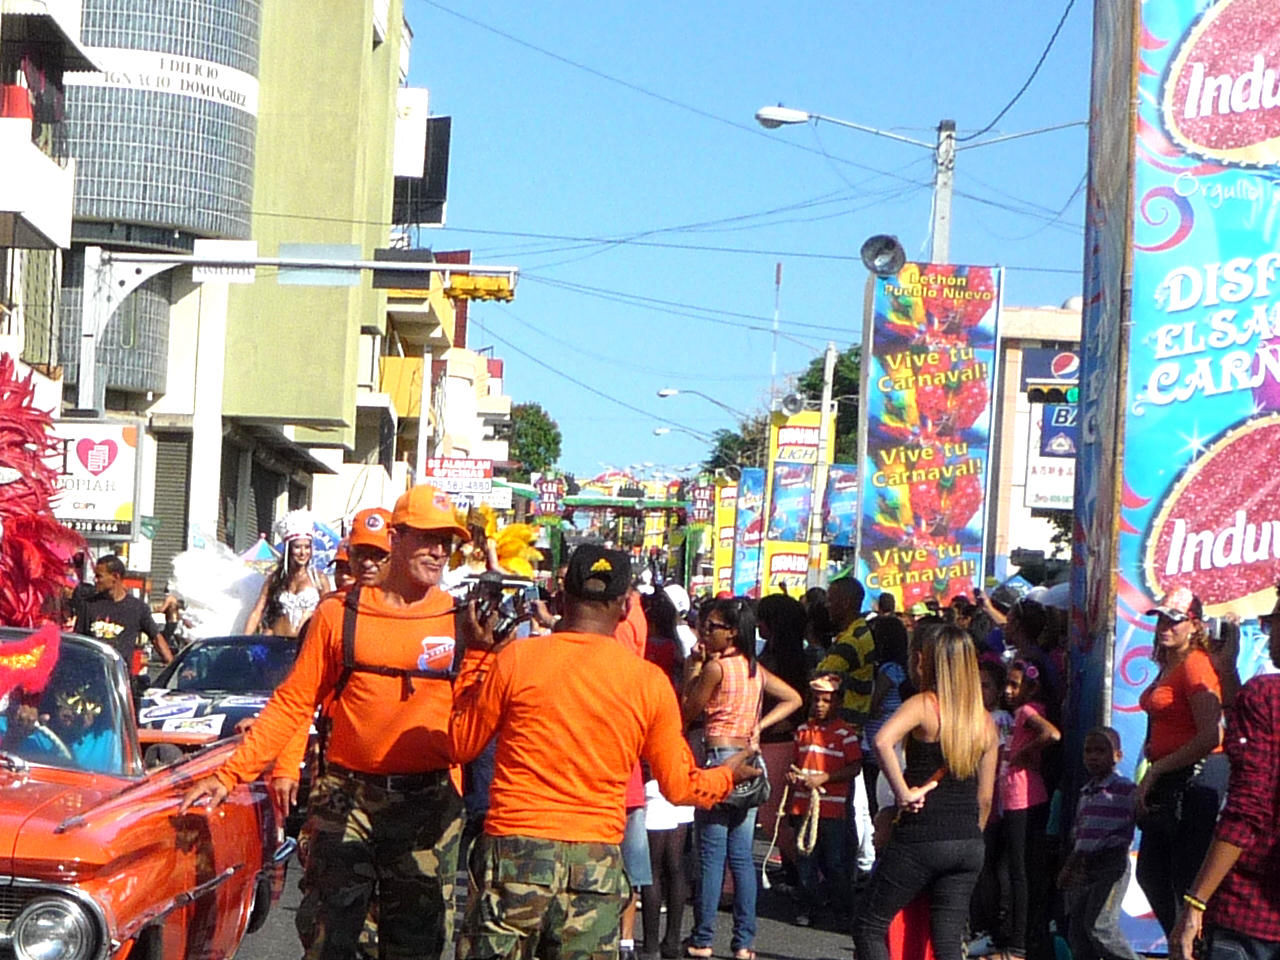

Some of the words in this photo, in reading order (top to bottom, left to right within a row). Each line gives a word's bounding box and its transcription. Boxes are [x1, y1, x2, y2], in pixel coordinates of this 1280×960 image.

[160, 57, 218, 80] EDIFICIO
[104, 71, 170, 88] IGNACIO
[180, 78, 247, 107] DOMINGUEZ
[909, 273, 967, 286] Lechón
[885, 284, 937, 298] Pueblo
[943, 287, 992, 300] Nuevo
[885, 351, 939, 370] Vive
[949, 347, 973, 362] tu
[878, 362, 988, 392] Carnaval!
[880, 446, 934, 465] Vive
[944, 442, 968, 457] tu
[872, 458, 983, 487] Carnaval!
[874, 548, 928, 567] Vive
[937, 544, 962, 559] tu
[866, 560, 976, 589] Carnaval!
